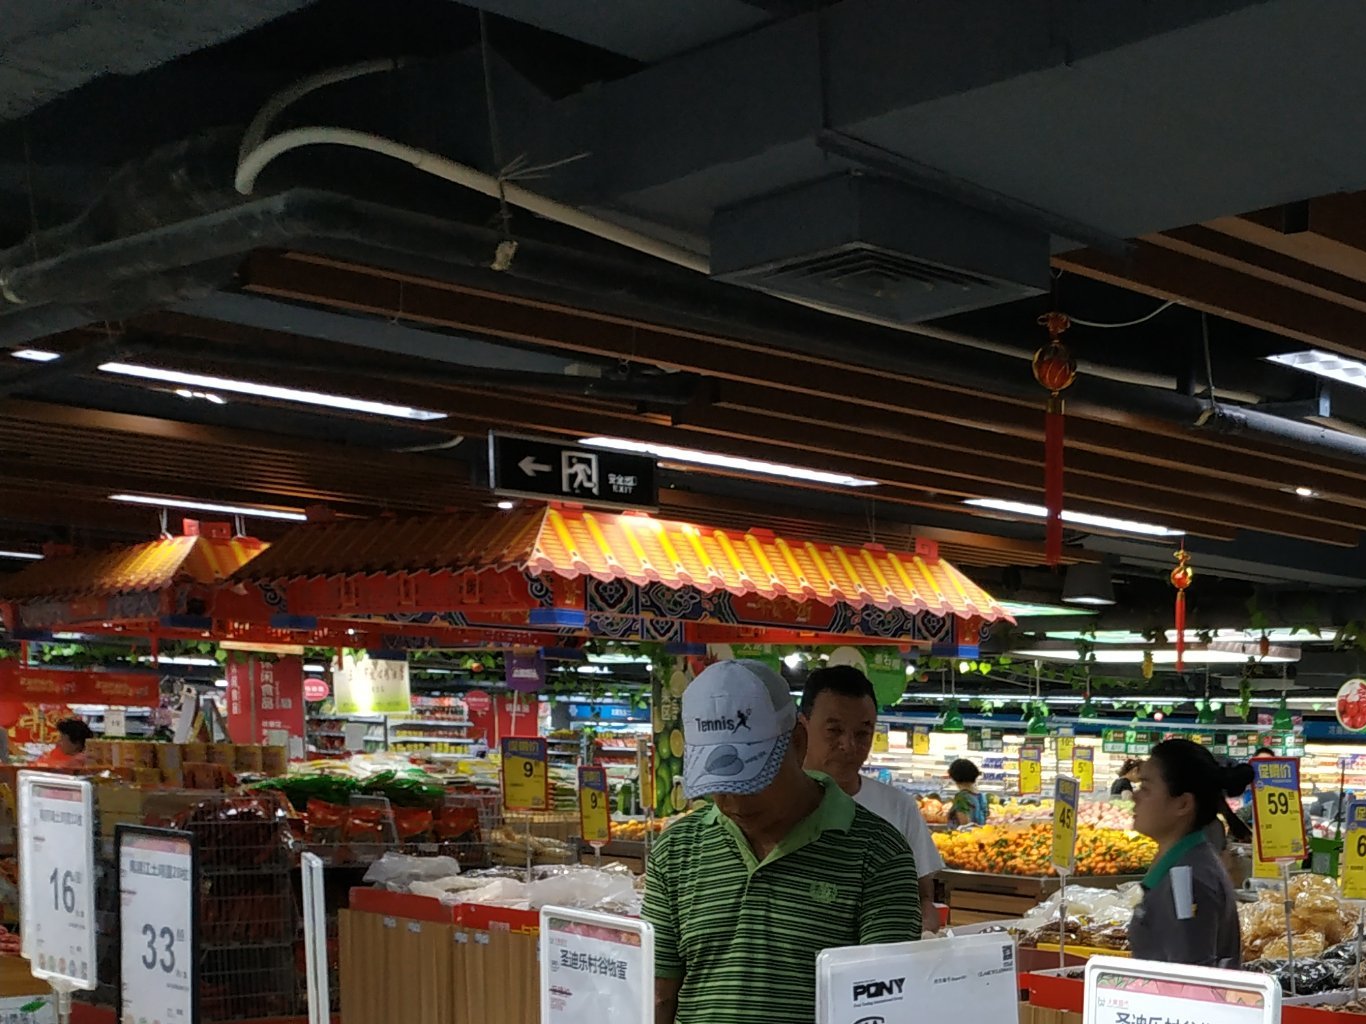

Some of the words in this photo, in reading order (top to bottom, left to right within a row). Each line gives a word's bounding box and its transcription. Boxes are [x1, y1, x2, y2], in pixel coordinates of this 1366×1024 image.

[612, 485, 633, 494] EXIT
[695, 715, 735, 734] Tennis
[522, 762, 534, 778] 9
[590, 792, 598, 810] 9
[1268, 793, 1288, 815] 59
[1059, 807, 1071, 829] 45
[50, 867, 75, 914] 16
[142, 923, 176, 975] 33
[559, 949, 628, 981] 圣迪乐村谷物蛋
[853, 977, 906, 1001] PONY
